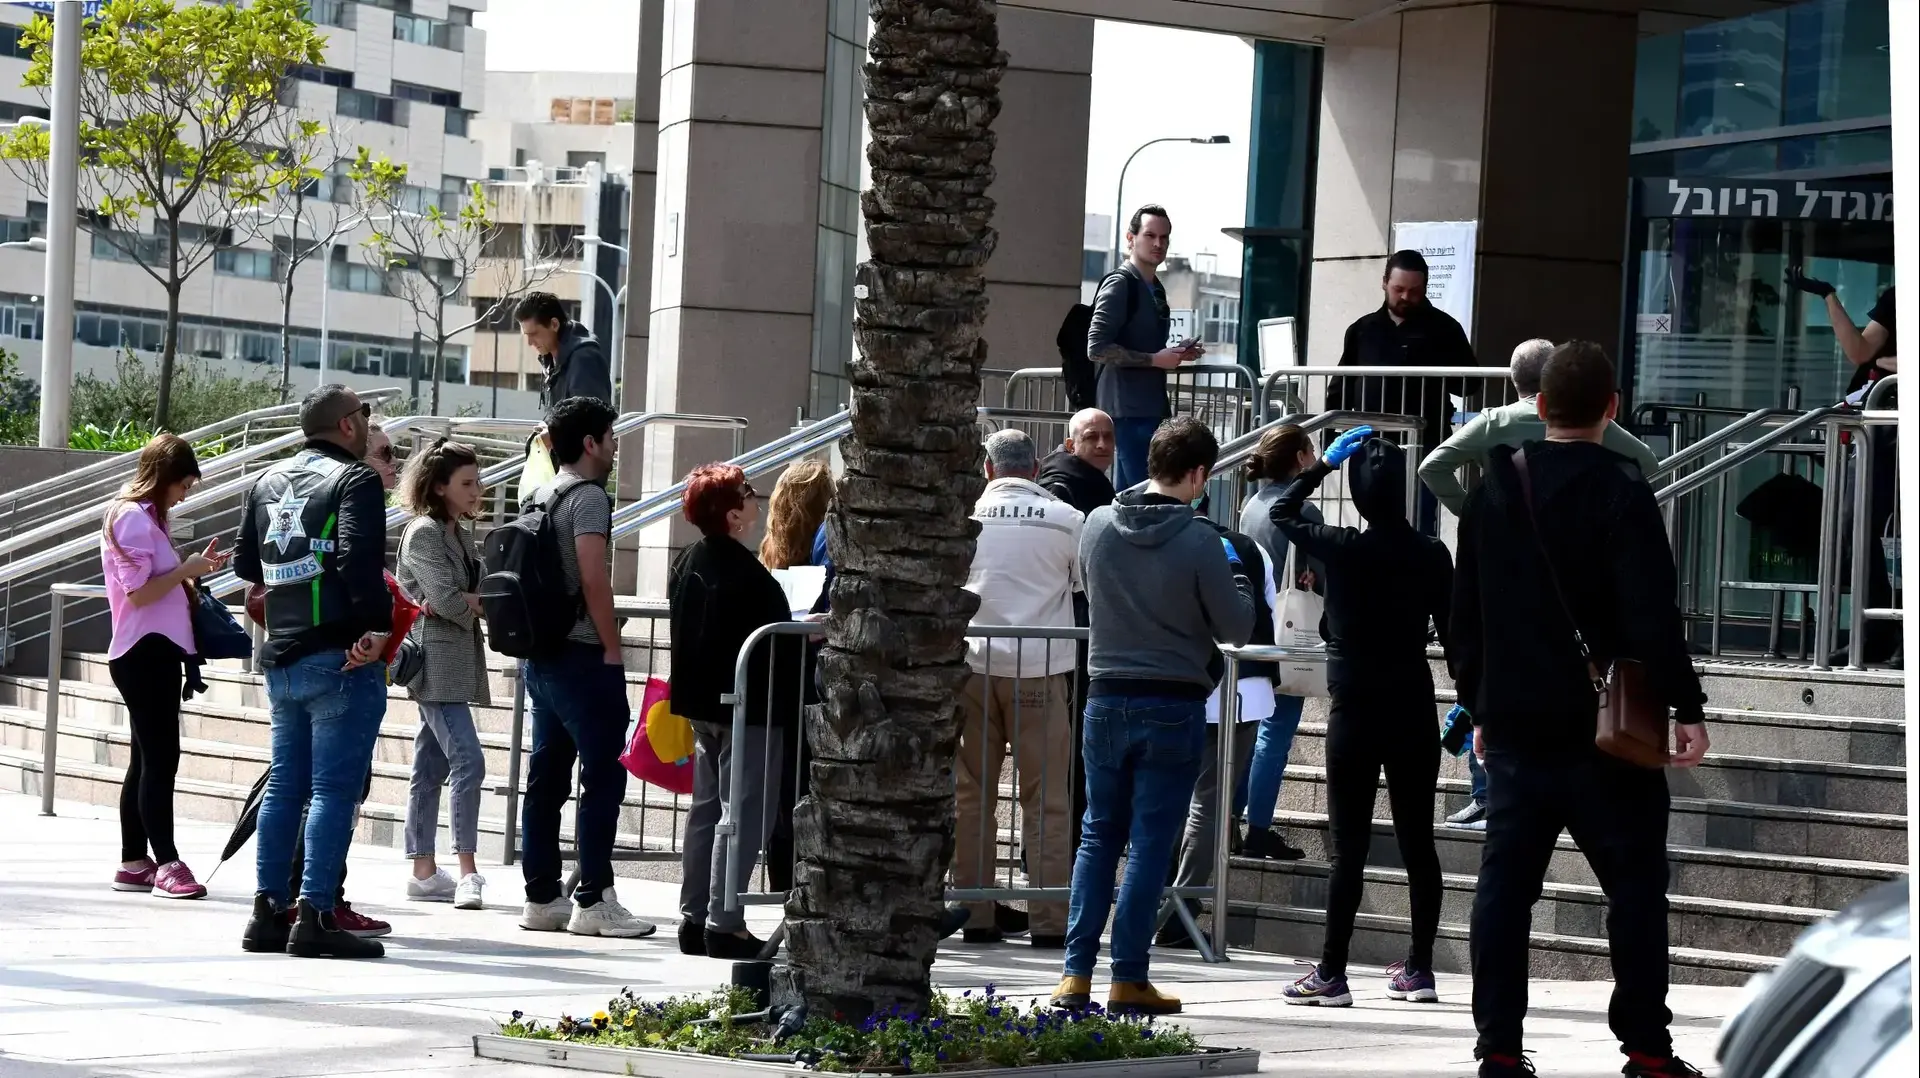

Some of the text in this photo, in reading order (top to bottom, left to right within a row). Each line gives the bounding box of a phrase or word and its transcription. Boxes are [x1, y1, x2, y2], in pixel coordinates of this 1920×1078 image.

[1668, 179, 1894, 222] מגדל היובל
[312, 540, 331, 551] MC
[275, 560, 317, 580] RIDERS
